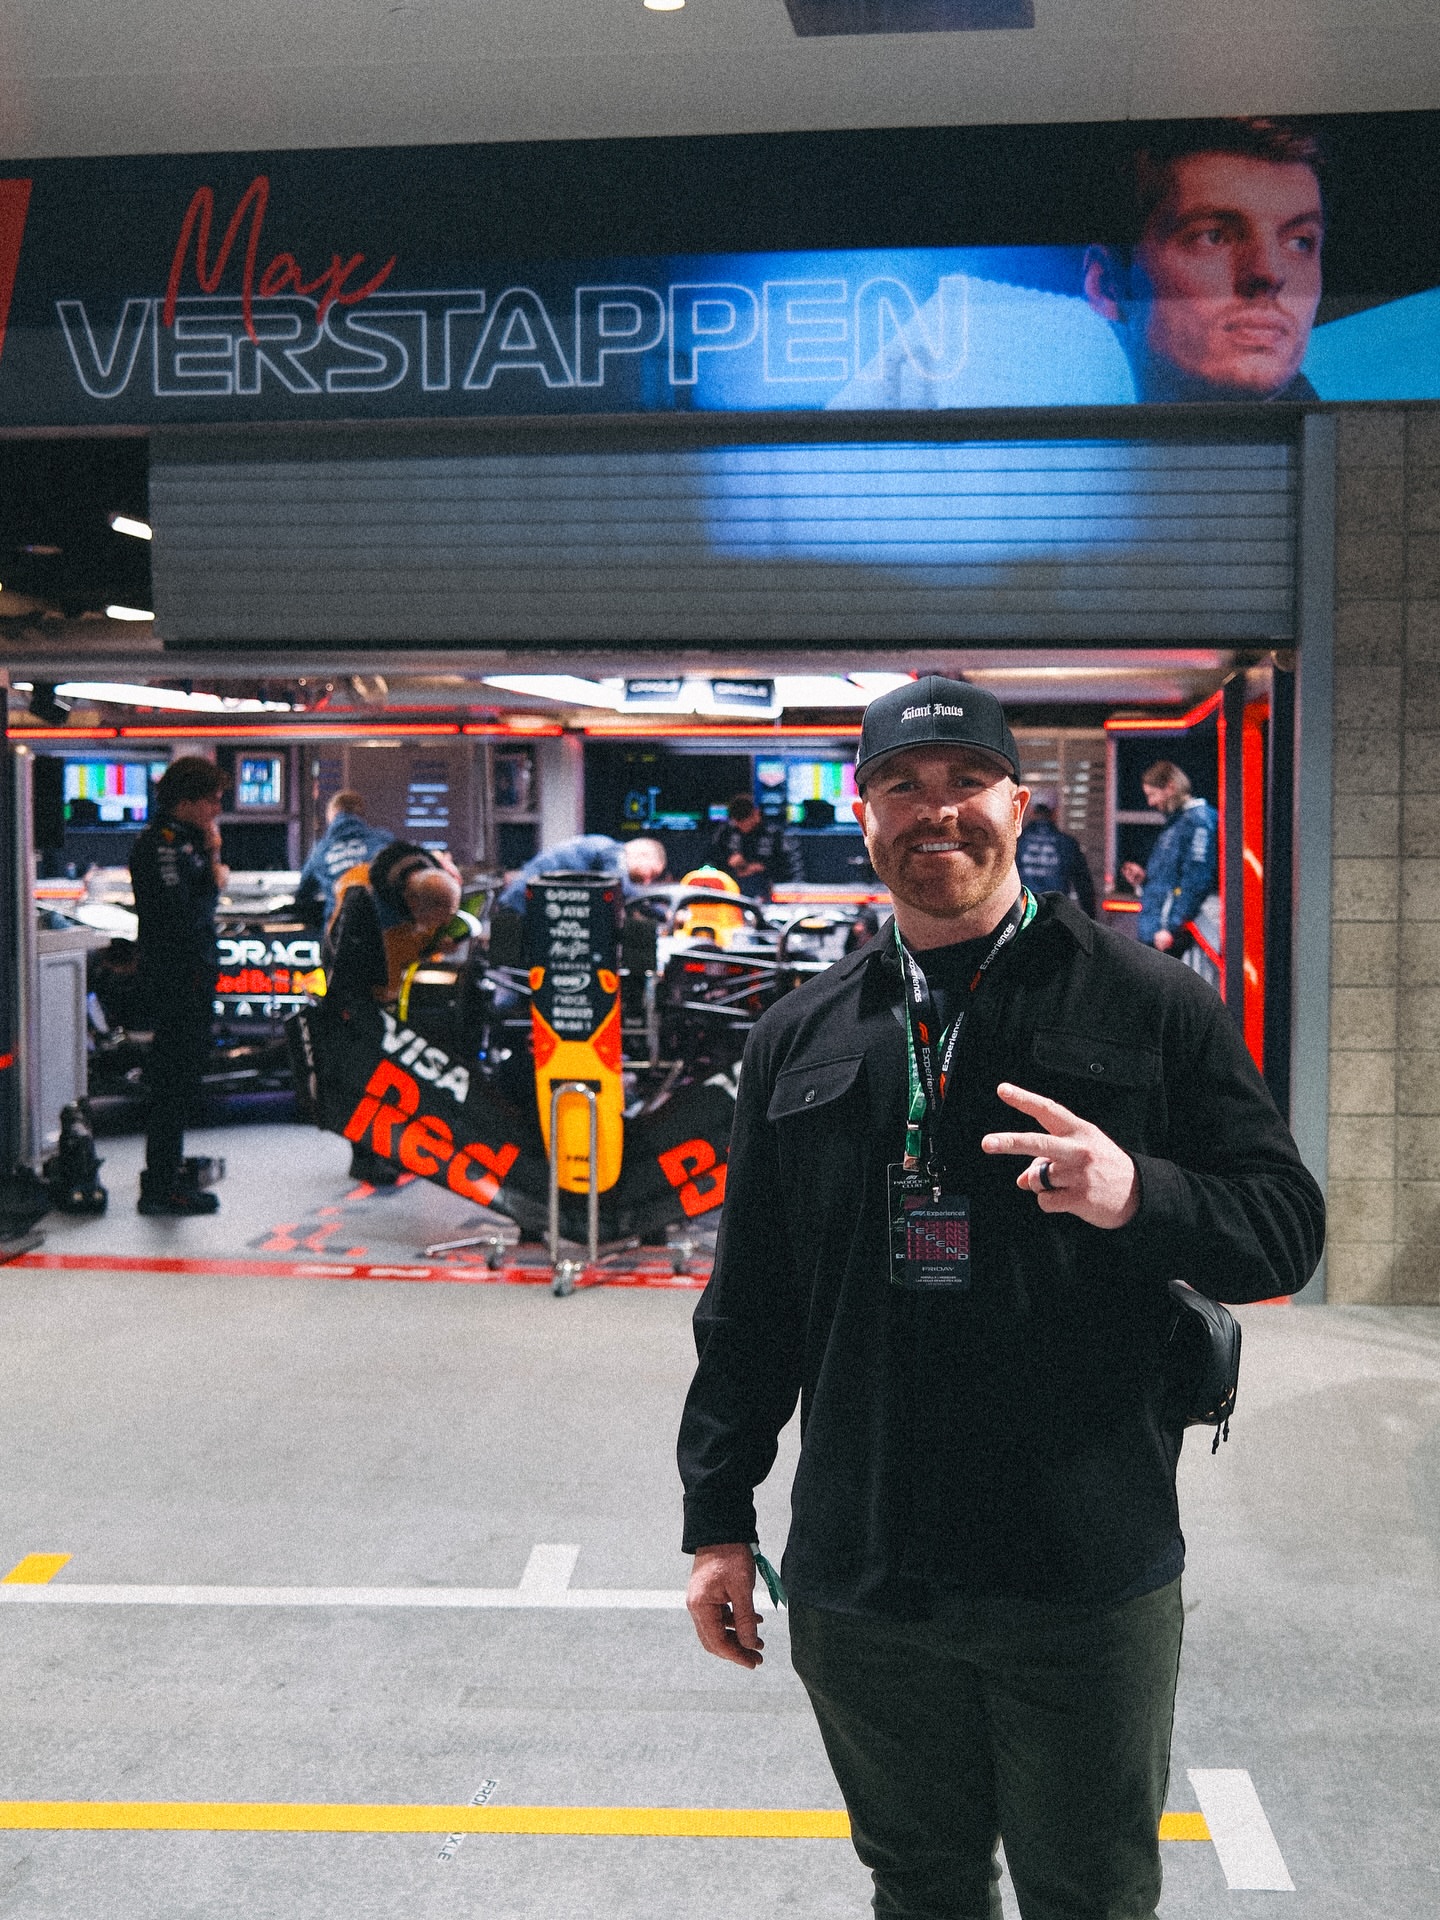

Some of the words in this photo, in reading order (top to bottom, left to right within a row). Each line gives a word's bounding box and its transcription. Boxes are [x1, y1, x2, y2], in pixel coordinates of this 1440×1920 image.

[163, 174, 397, 346] Max
[56, 275, 971, 399] VERSTAPPEN
[901, 703, 931, 723] Giant
[933, 703, 964, 717] Haus
[979, 922, 1015, 970] Experiences
[380, 1009, 470, 1104] VISA
[942, 1011, 965, 1072] Experiences
[343, 1058, 521, 1207] Red
[438, 1831, 462, 1861] XLE
